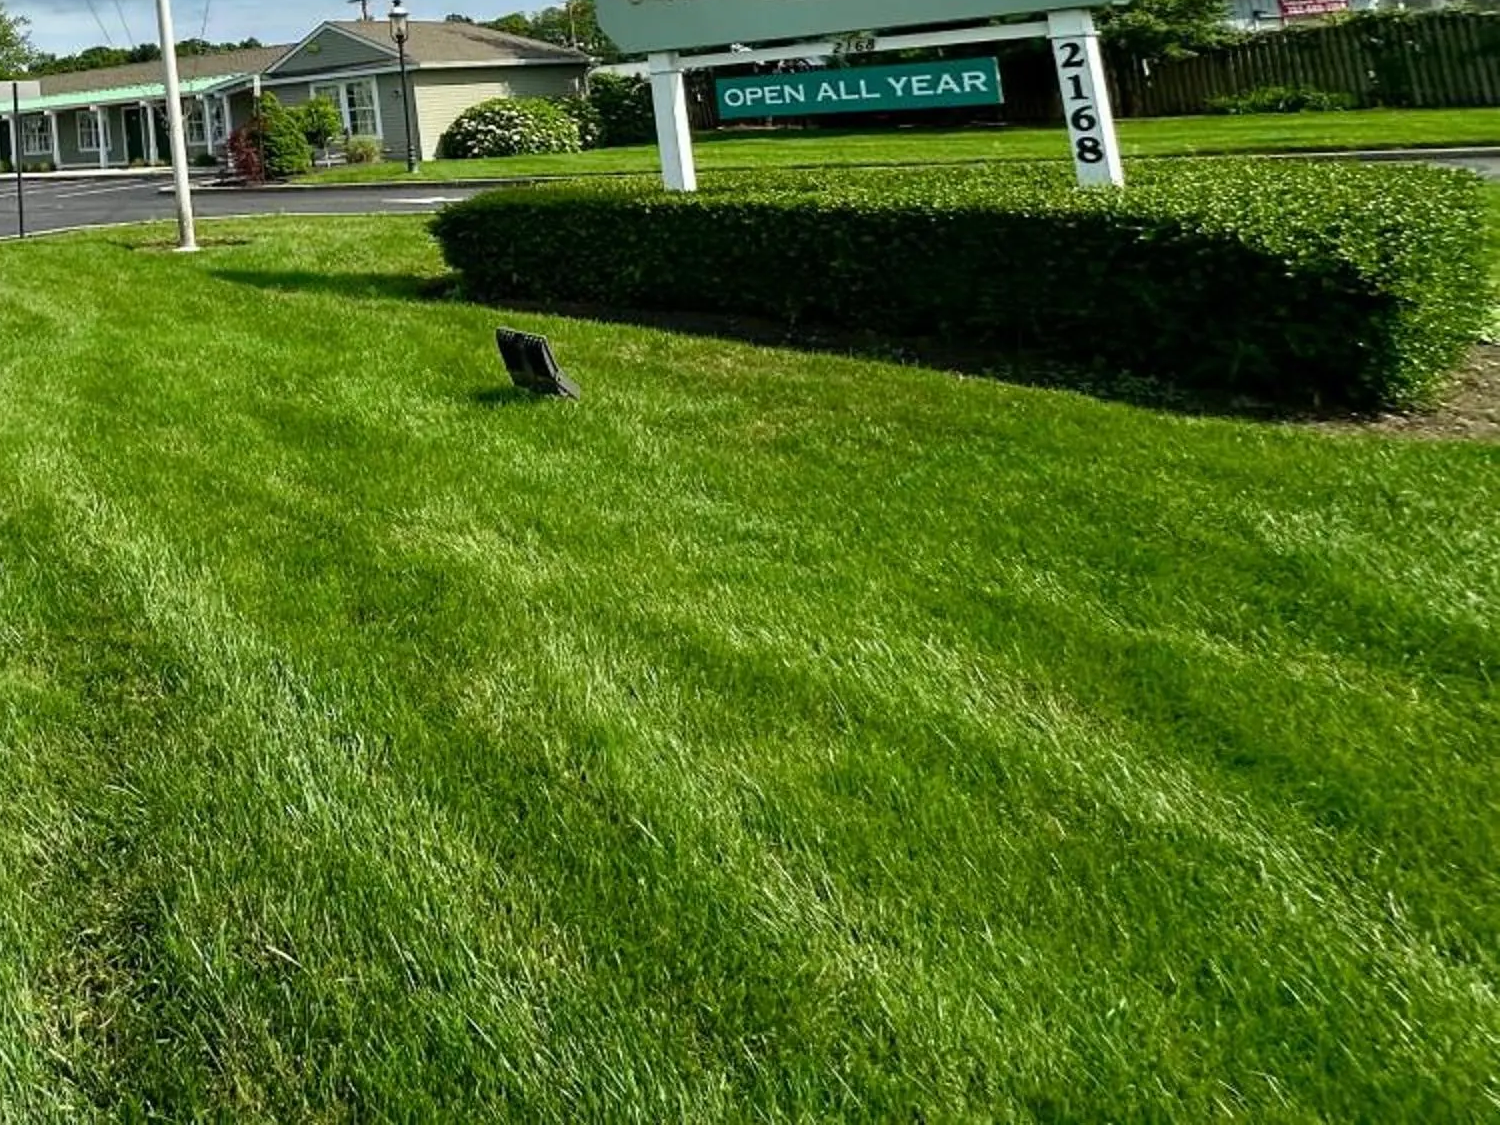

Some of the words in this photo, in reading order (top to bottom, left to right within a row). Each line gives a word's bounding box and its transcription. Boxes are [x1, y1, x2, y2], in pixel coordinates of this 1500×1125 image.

[832, 38, 876, 54] 2168
[723, 83, 806, 107] OPEN
[816, 78, 881, 102] ALL
[886, 70, 989, 97] YEAR
[1058, 41, 1104, 164] 2168
